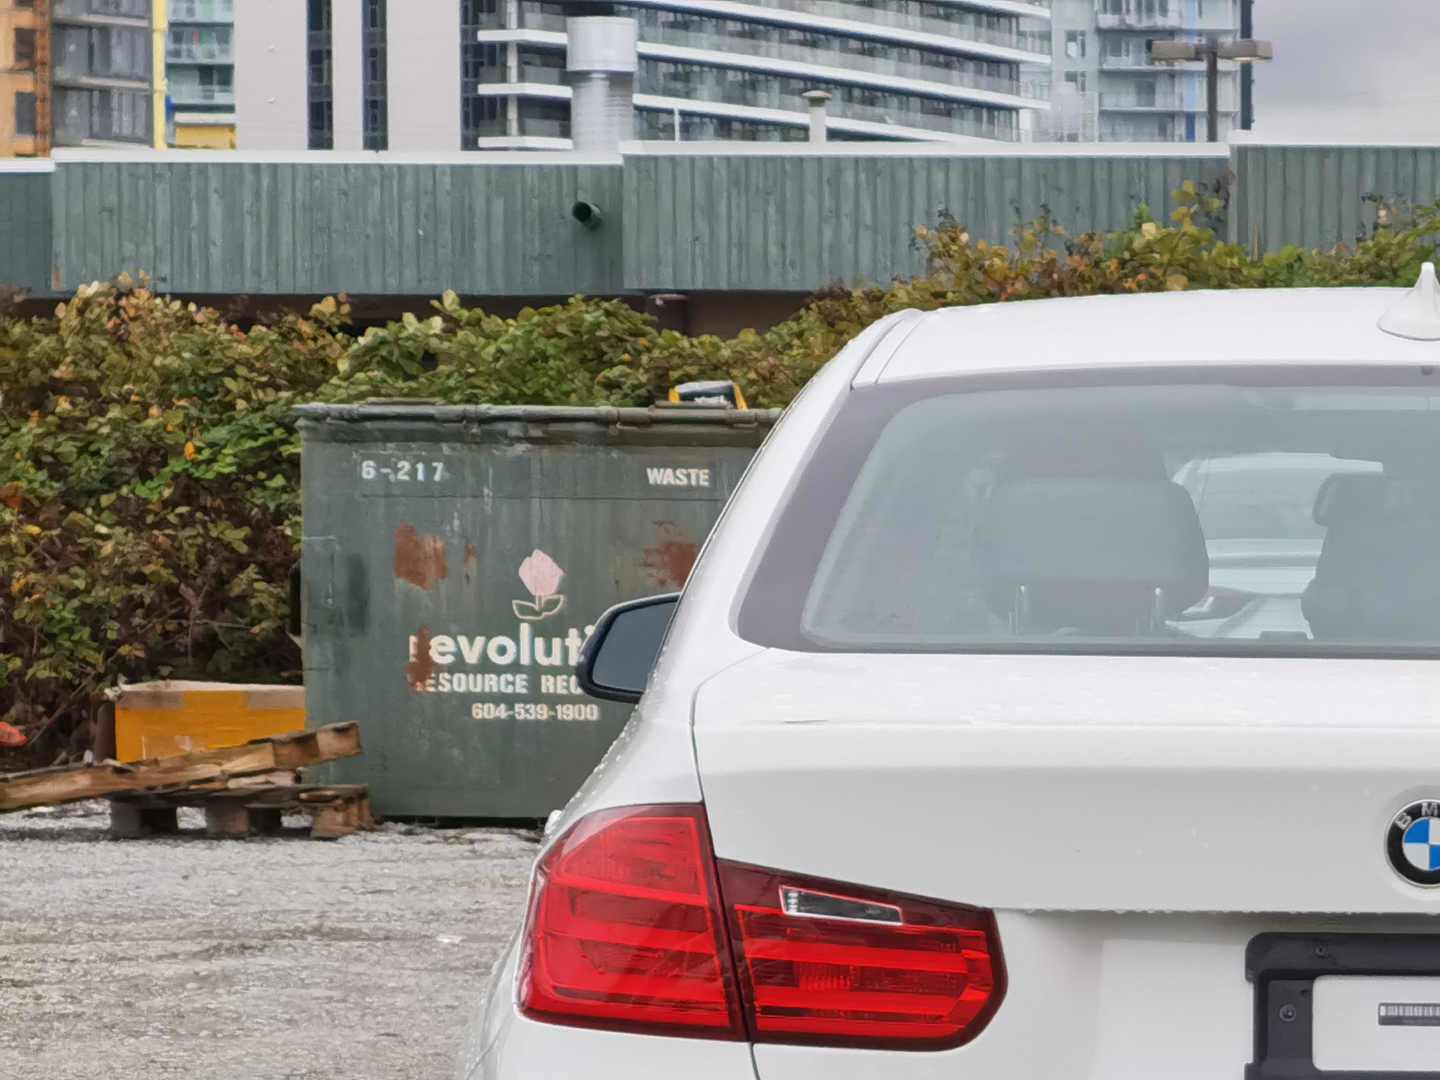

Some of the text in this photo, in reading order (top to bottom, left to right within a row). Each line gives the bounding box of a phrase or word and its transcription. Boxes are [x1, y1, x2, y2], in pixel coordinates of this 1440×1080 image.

[647, 467, 710, 487] WASTE
[413, 672, 529, 694] ESOURCE
[471, 703, 600, 721] 604-539-1900
